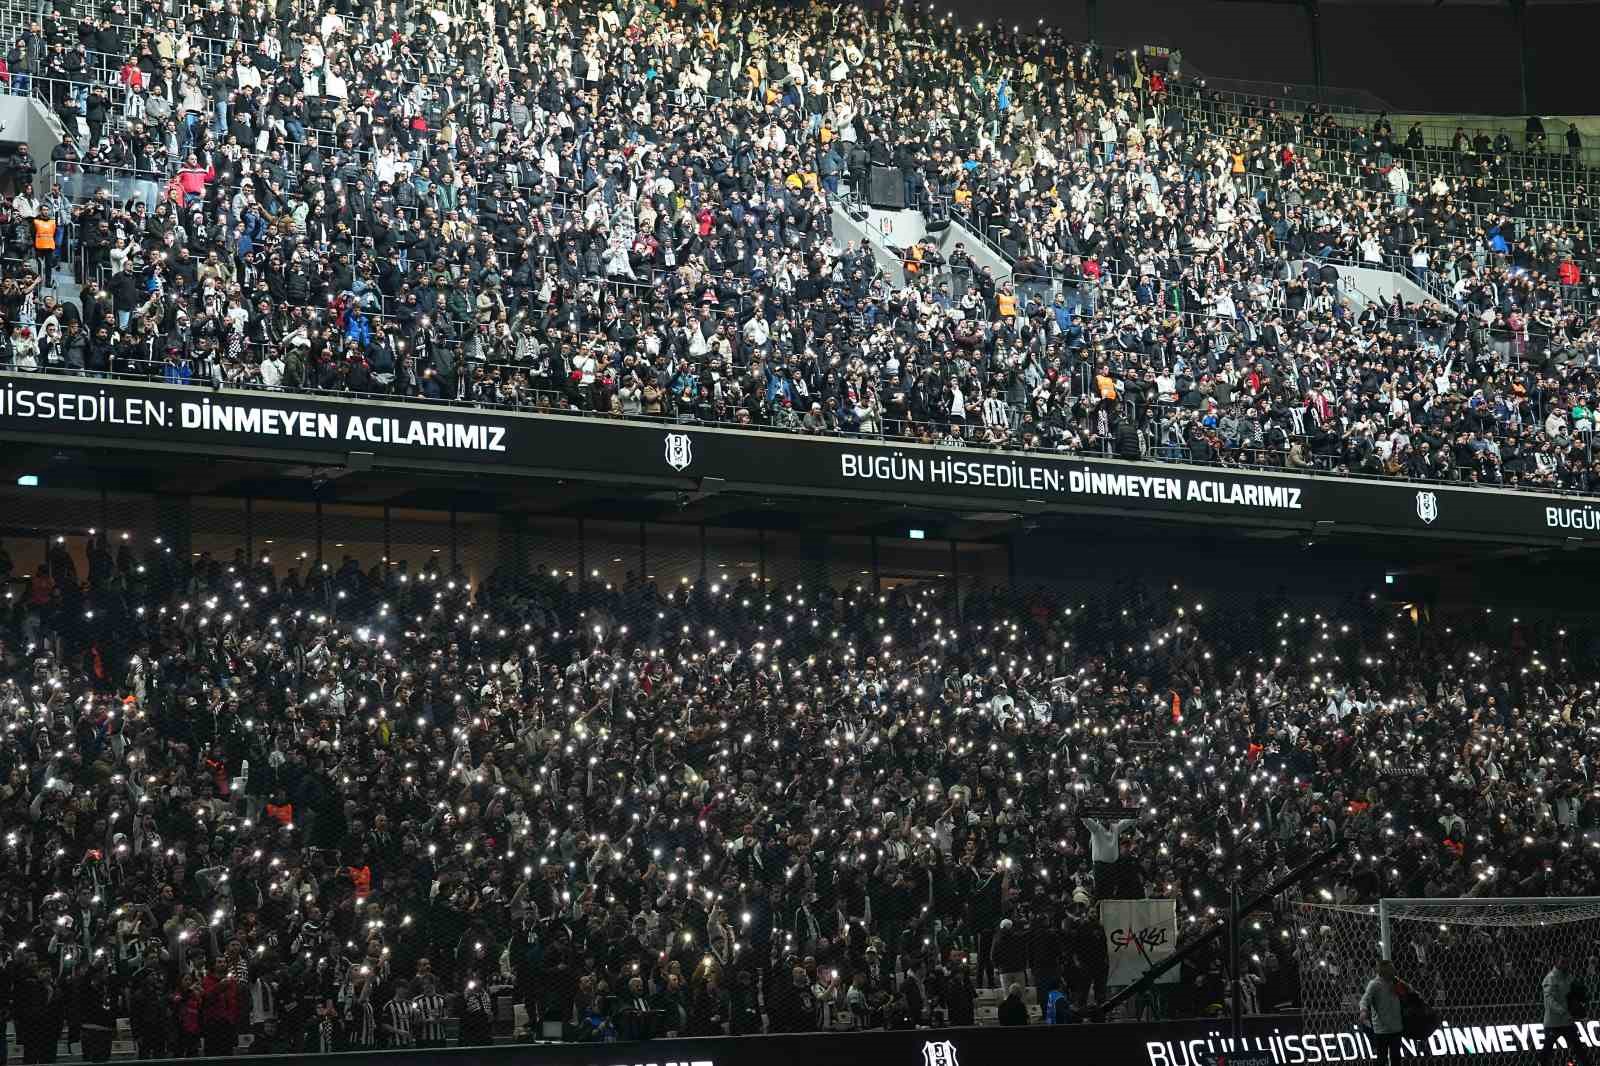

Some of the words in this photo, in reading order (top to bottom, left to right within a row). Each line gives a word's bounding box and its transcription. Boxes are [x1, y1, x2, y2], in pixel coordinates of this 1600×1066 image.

[0, 383, 173, 427] İSSEDİLEN:
[181, 398, 338, 439] DİNMEYEN
[345, 416, 506, 451] ACILARIMIZ
[841, 452, 924, 481] BUGÜN
[931, 455, 1065, 491] HİSSEDİLEN:
[1069, 467, 1181, 500] DİNMEYEN
[1187, 480, 1302, 509] ACILARIMIZ
